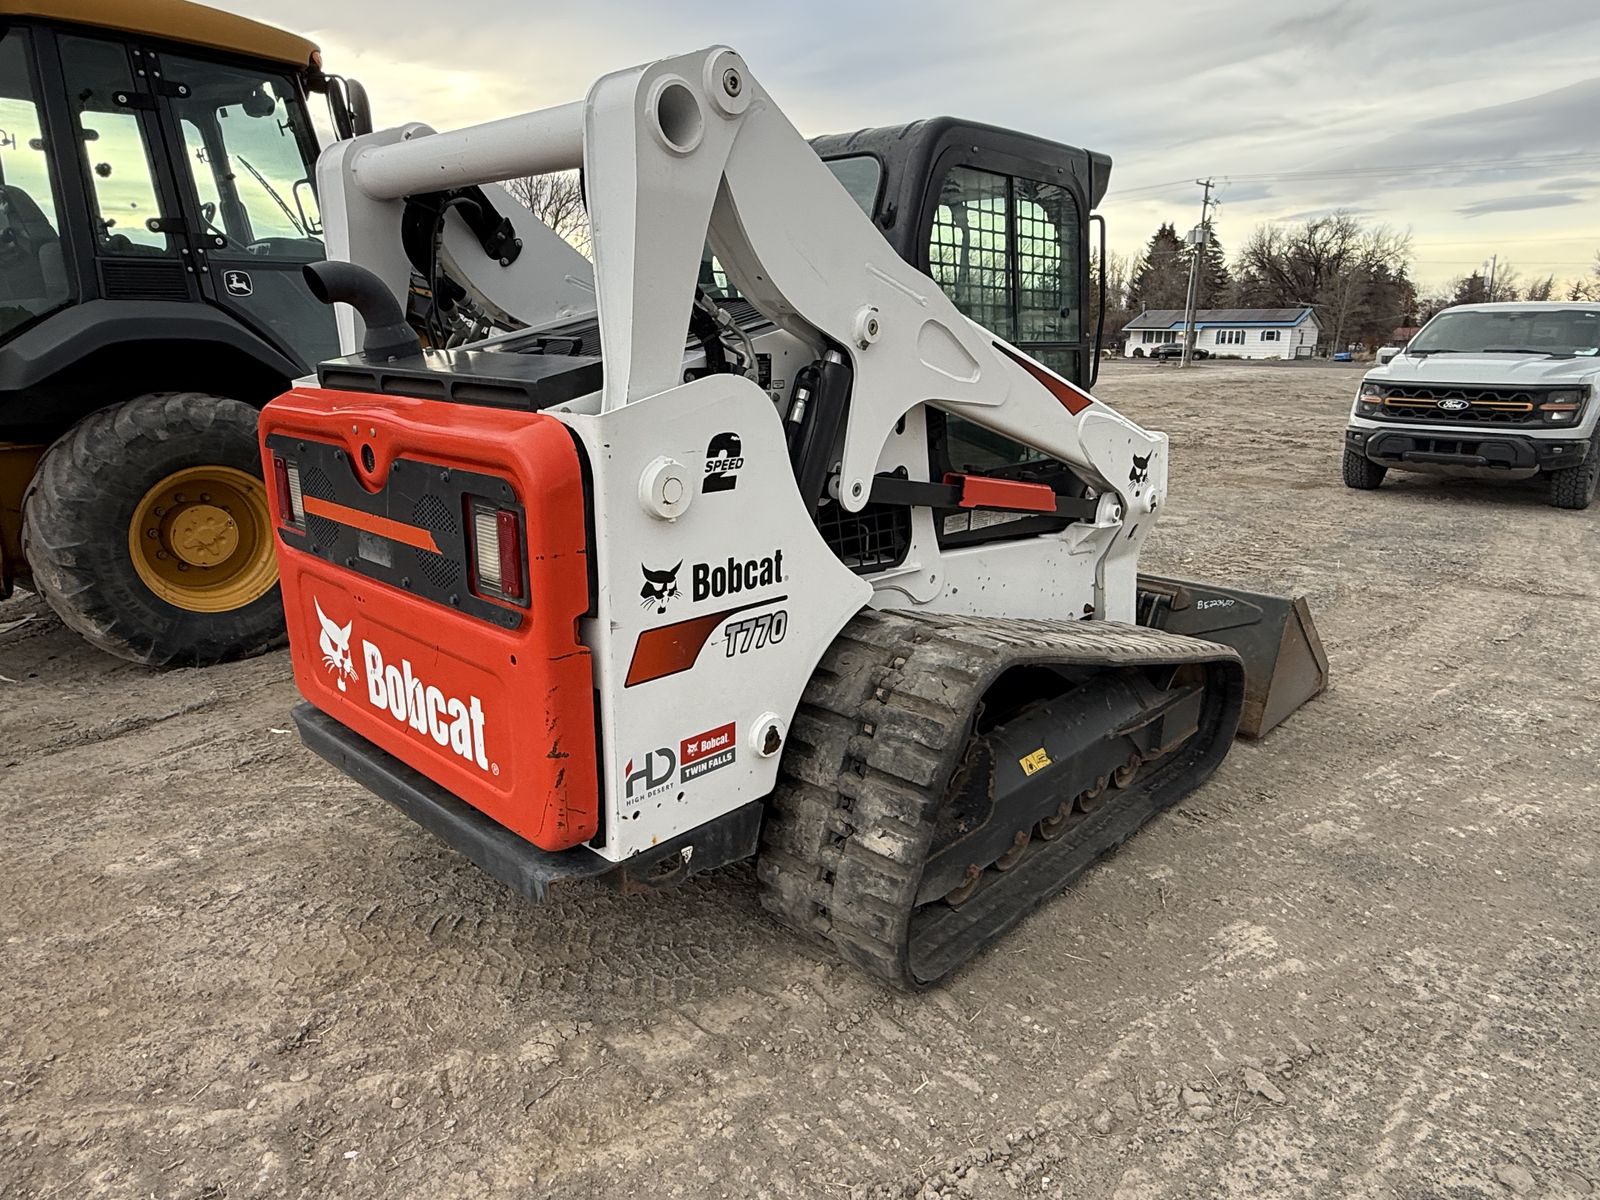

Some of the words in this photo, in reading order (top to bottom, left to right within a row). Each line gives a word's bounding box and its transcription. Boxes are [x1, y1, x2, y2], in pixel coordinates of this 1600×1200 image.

[1442, 399, 1464, 409] Ford
[702, 432, 741, 493] 2
[704, 457, 744, 474] SPEED
[693, 549, 783, 603] Bobcat
[725, 610, 788, 658] T770
[362, 639, 489, 771] Bobcat
[701, 732, 729, 752] Bobcat
[625, 747, 676, 799] HD
[685, 762, 707, 777] TWIN
[708, 752, 732, 769] FALLS
[626, 795, 645, 807] HIGH
[647, 782, 674, 798] DESERT
